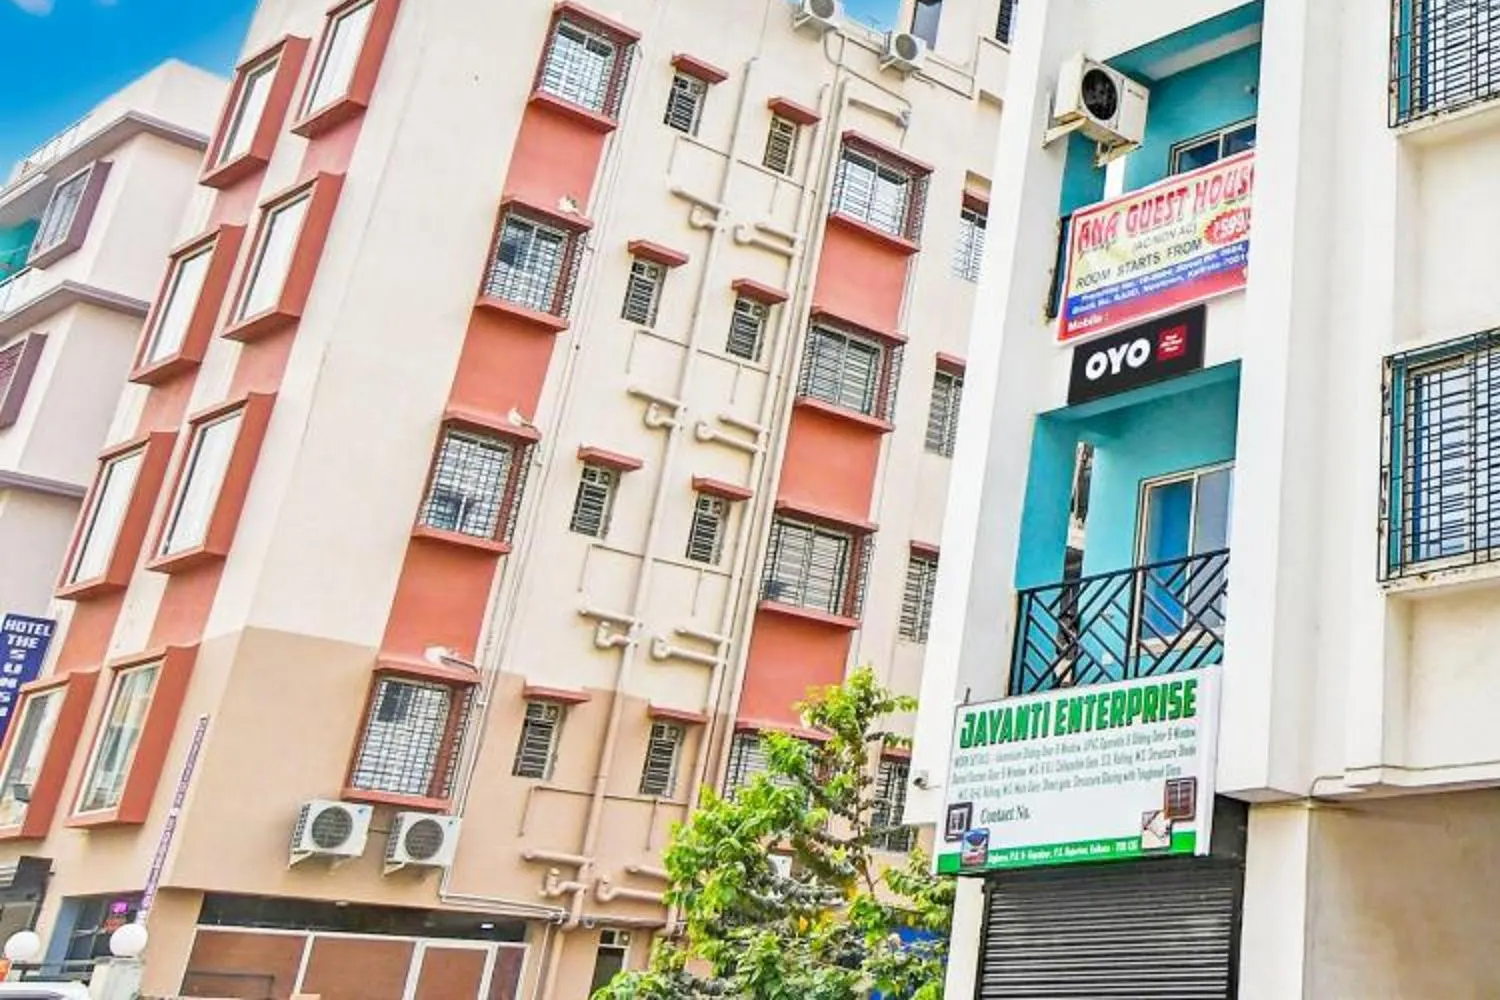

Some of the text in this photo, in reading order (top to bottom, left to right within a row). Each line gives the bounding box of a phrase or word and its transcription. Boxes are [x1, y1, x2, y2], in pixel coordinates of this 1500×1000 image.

[1126, 188, 1188, 236] GUEST
[1192, 164, 1254, 213] HOUS
[1075, 238, 1202, 289] ROOM STARTS FROM
[1085, 337, 1150, 381] OYO
[4, 618, 53, 637] HOTEL
[7, 633, 40, 649] THE
[959, 678, 1199, 749] JAYANTI ENTERPRISE
[980, 807, 1015, 825] Contact
